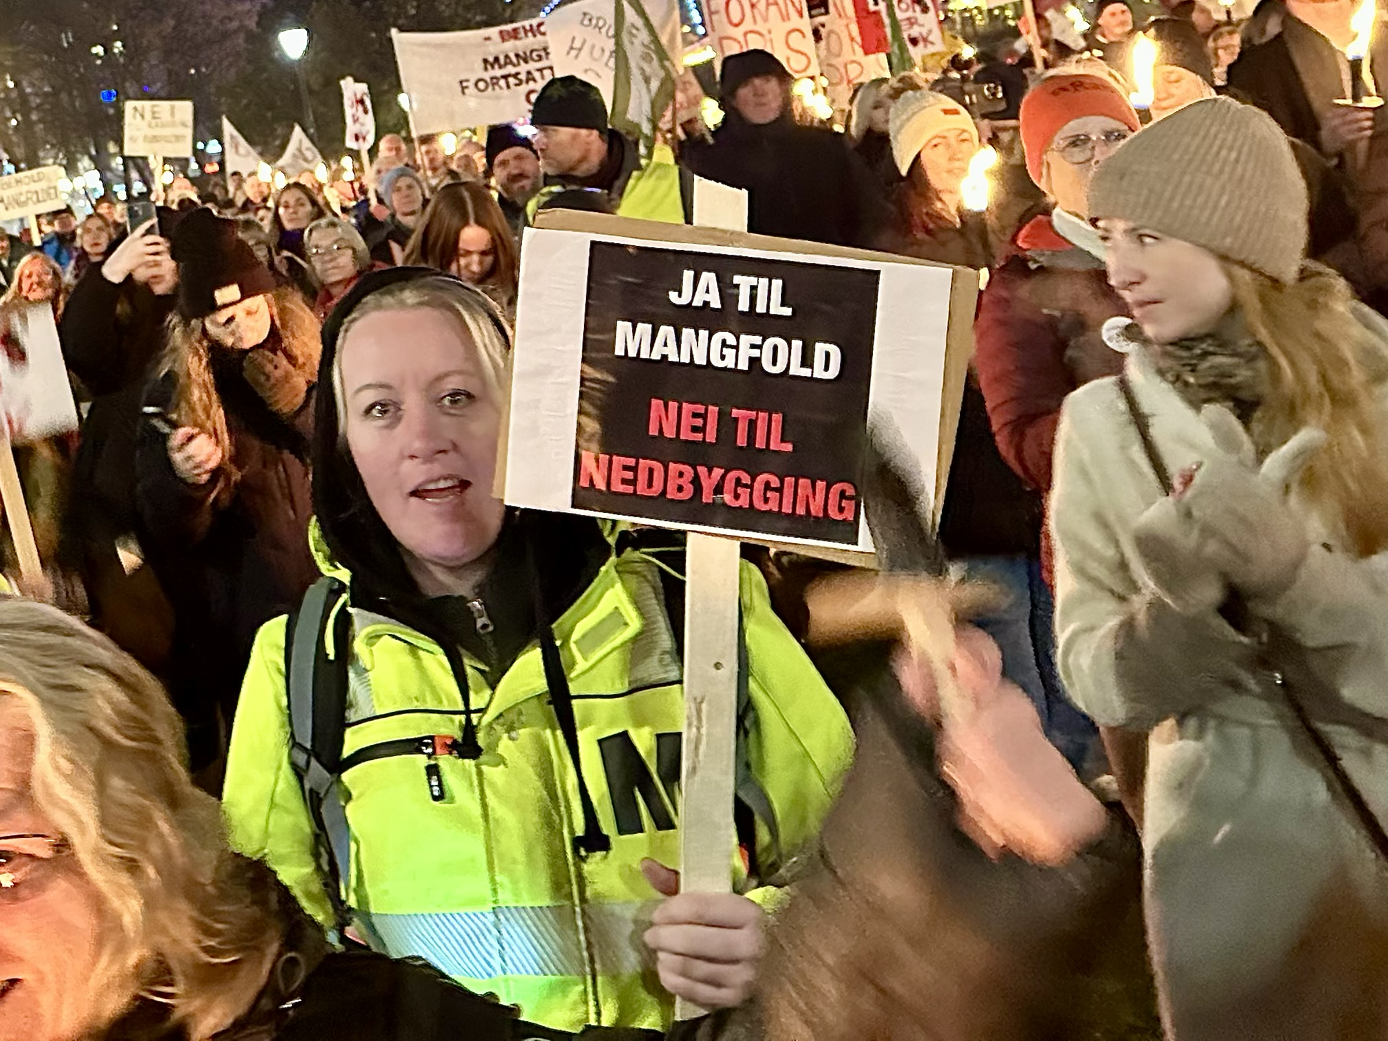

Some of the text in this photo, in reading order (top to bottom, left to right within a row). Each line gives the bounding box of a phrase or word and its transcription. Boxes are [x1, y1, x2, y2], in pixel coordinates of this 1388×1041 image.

[580, 11, 615, 39] BRU
[482, 46, 550, 72] MANGF
[668, 269, 793, 316] JA TIL
[614, 320, 842, 380] MANGFOLD
[648, 398, 793, 452] NEI TIL
[579, 450, 856, 522] NEDBYGGING
